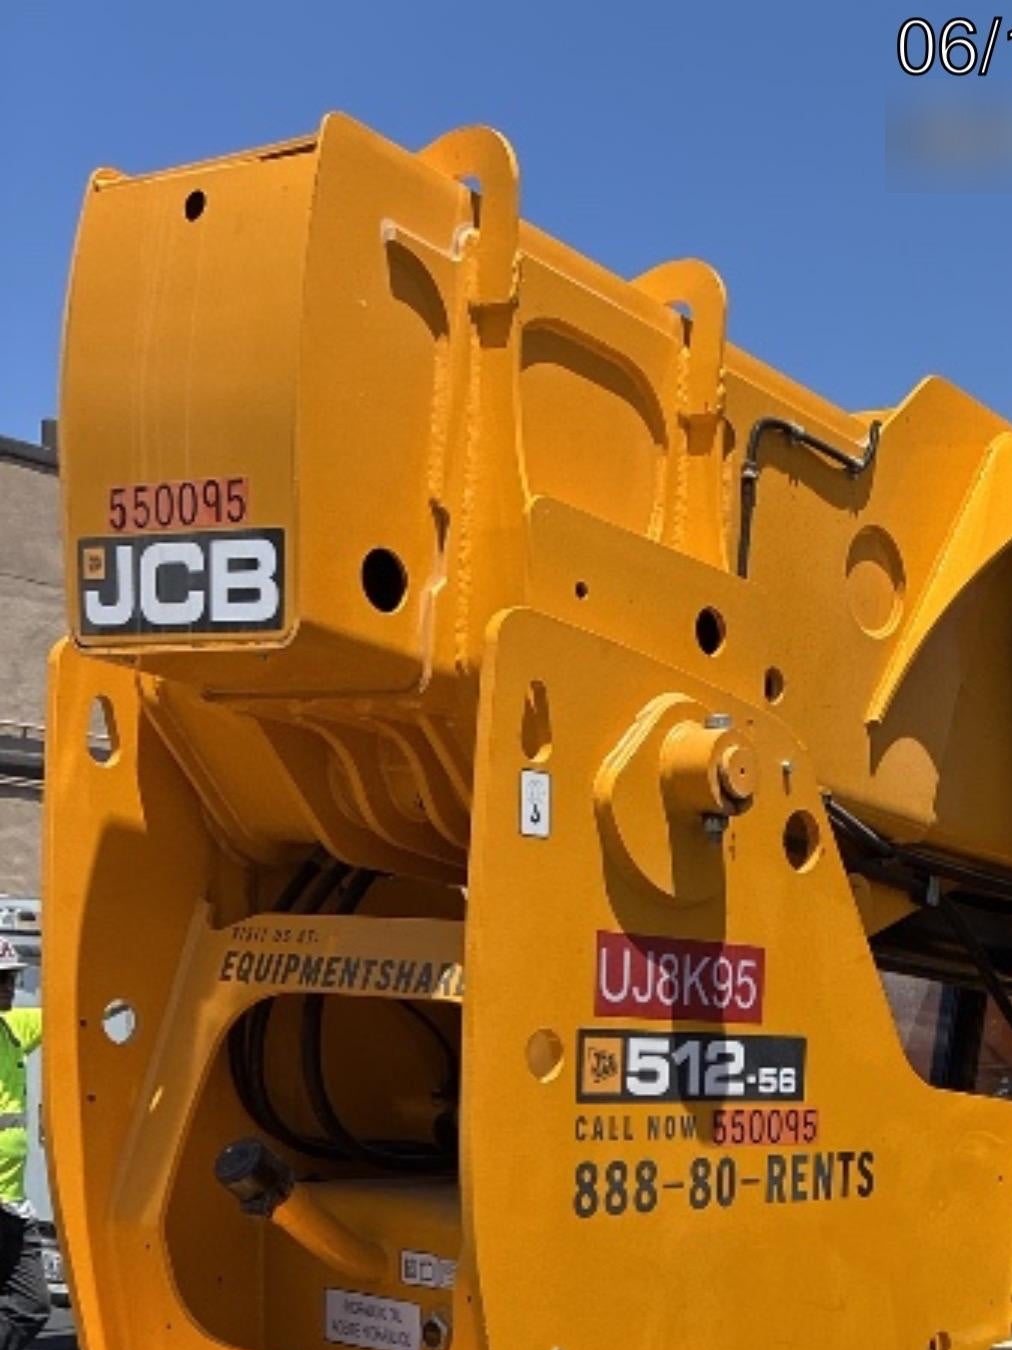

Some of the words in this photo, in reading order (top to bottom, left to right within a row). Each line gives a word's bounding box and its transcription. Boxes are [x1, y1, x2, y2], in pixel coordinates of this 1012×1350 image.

[109, 476, 247, 530] 550095
[84, 538, 280, 625] JCB
[600, 947, 758, 1009] UJ8K95
[574, 1114, 634, 1141] CALL
[646, 1114, 697, 1141] NOW
[712, 1108, 817, 1145] 550095
[573, 1150, 874, 1219] 888-80-RENTS
